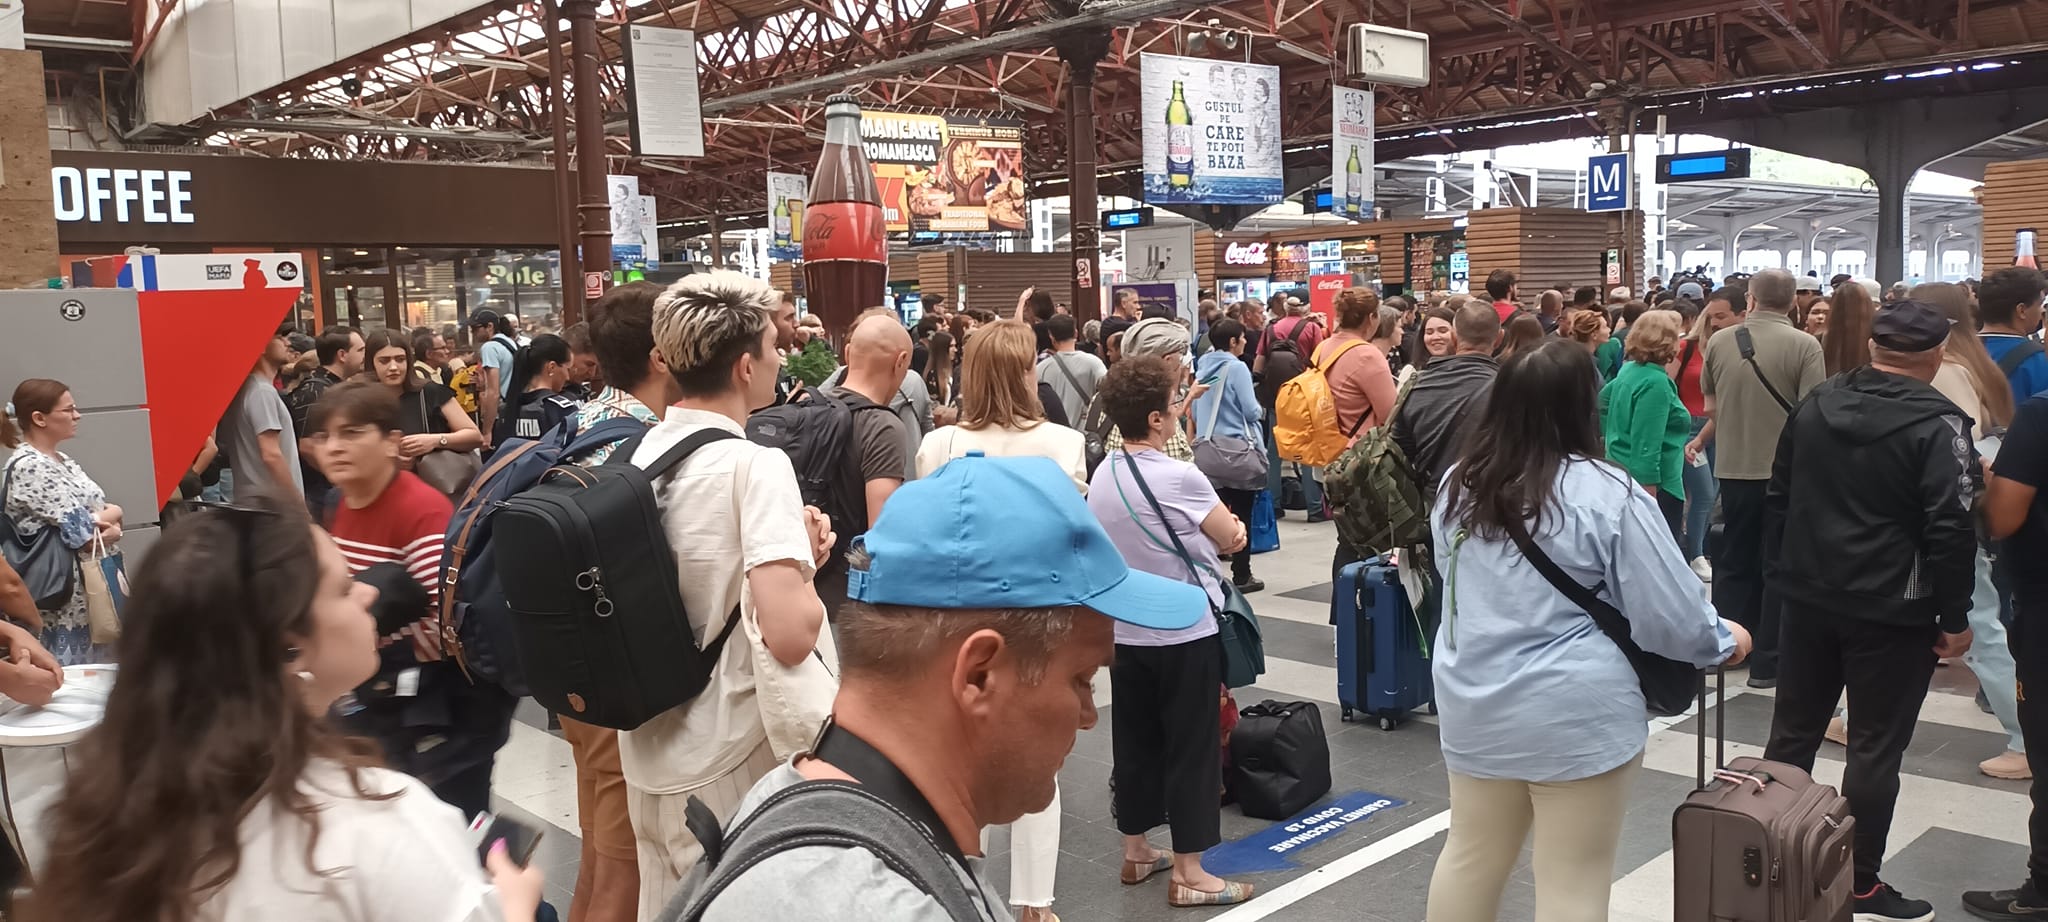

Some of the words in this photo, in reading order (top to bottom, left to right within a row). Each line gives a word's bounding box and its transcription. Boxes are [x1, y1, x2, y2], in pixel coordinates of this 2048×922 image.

[1205, 101, 1244, 113] GUSTUL
[1220, 114, 1230, 123] PE
[860, 117, 940, 141] MANCARE
[1205, 125, 1244, 140] CARE
[862, 141, 937, 162] ROMANEASCA
[1207, 142, 1219, 152] TE
[1221, 142, 1244, 152] POTI
[1207, 154, 1245, 169] BAZA
[1593, 162, 1620, 194] M
[1302, 807, 1343, 825] COVID
[1339, 799, 1392, 822] CABINET
[1284, 823, 1305, 832] 19
[1268, 820, 1346, 852] VACCINARE
